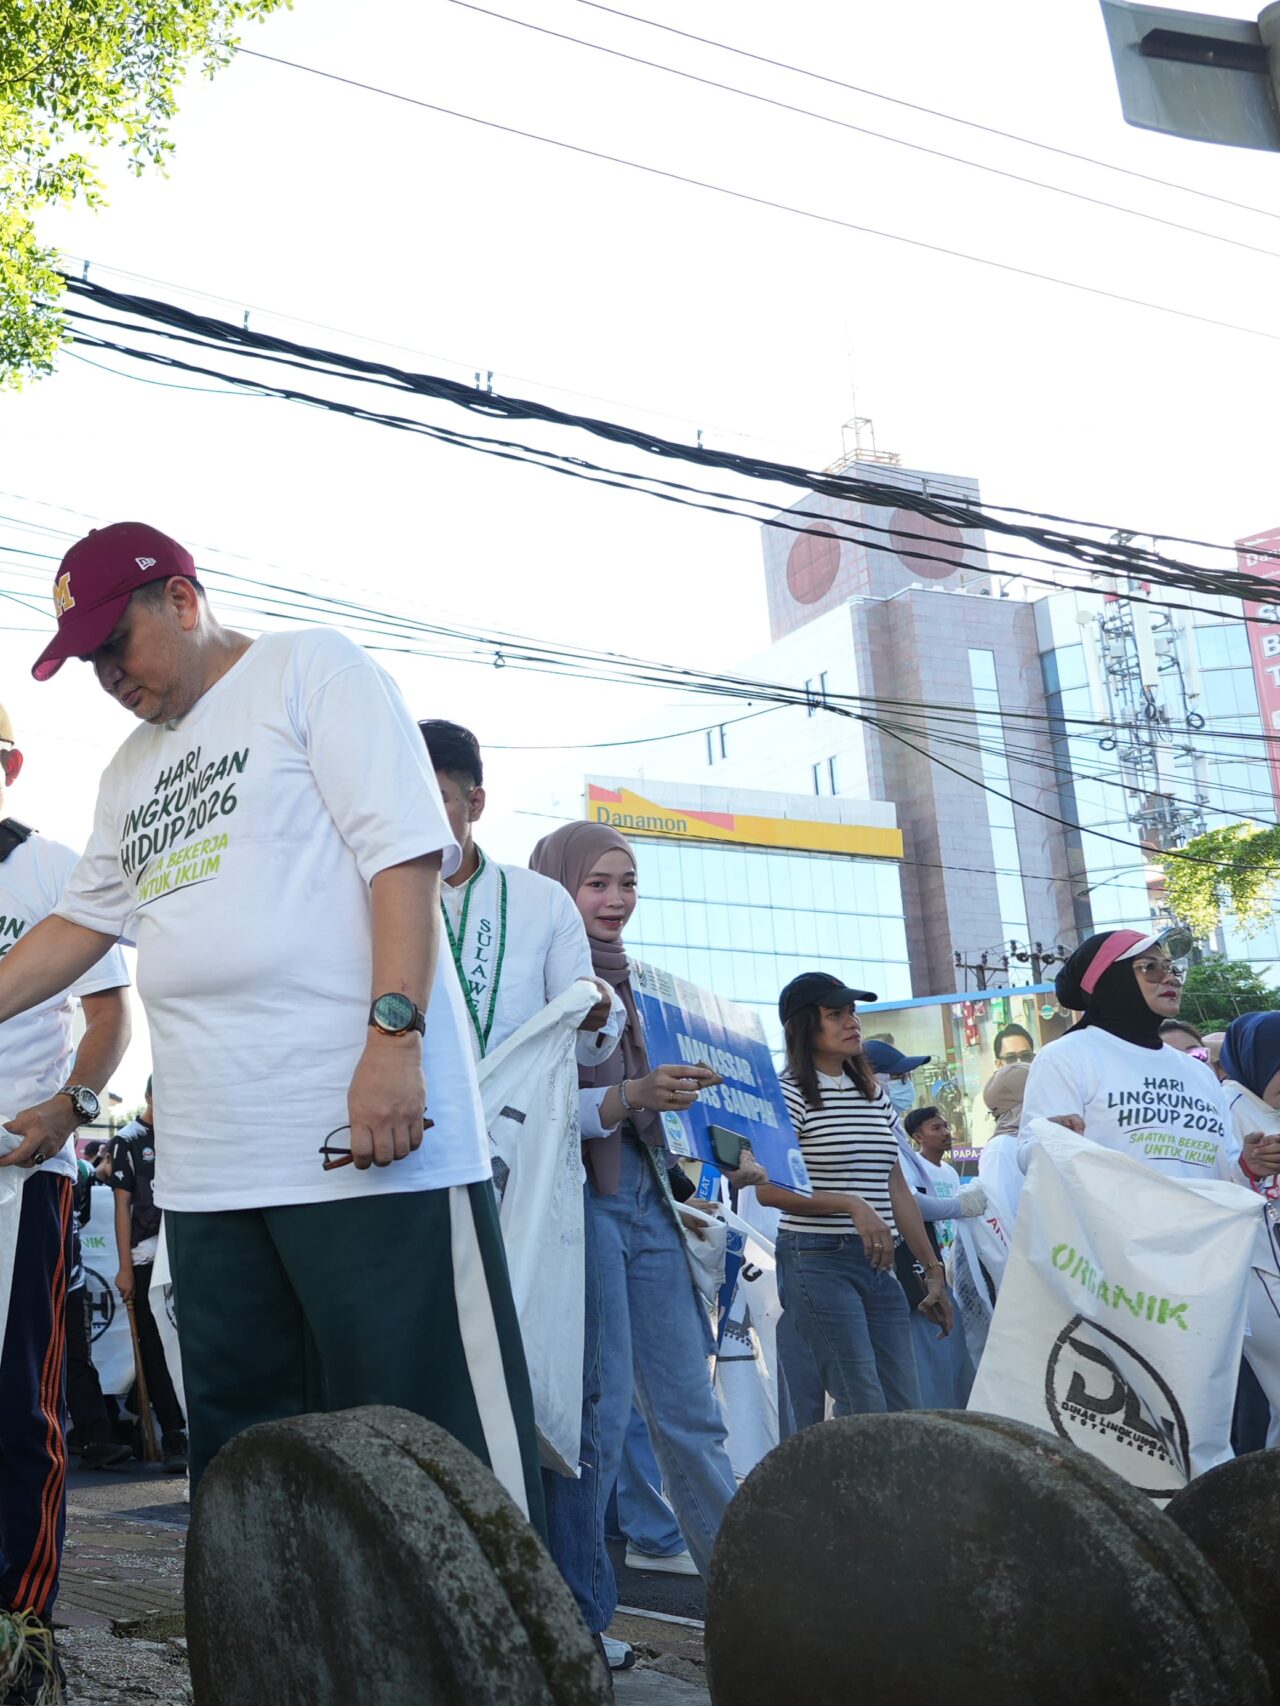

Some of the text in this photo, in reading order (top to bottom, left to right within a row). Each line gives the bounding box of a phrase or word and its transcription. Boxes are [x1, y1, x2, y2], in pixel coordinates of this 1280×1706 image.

[154, 746, 201, 795] HARI
[120, 748, 249, 841] INGKUNGAN
[121, 783, 237, 877] HIDUP 2026
[596, 805, 688, 833] Danamon
[166, 832, 229, 868] BEKERJA
[138, 874, 171, 901] NTUK
[174, 854, 220, 886] IKLIM
[1144, 1077, 1184, 1092] HARI
[1118, 1106, 1225, 1137] HIDUP 2026
[1144, 1143, 1216, 1165] UNTUK IKLIM
[1061, 1402, 1097, 1422] DINAS
